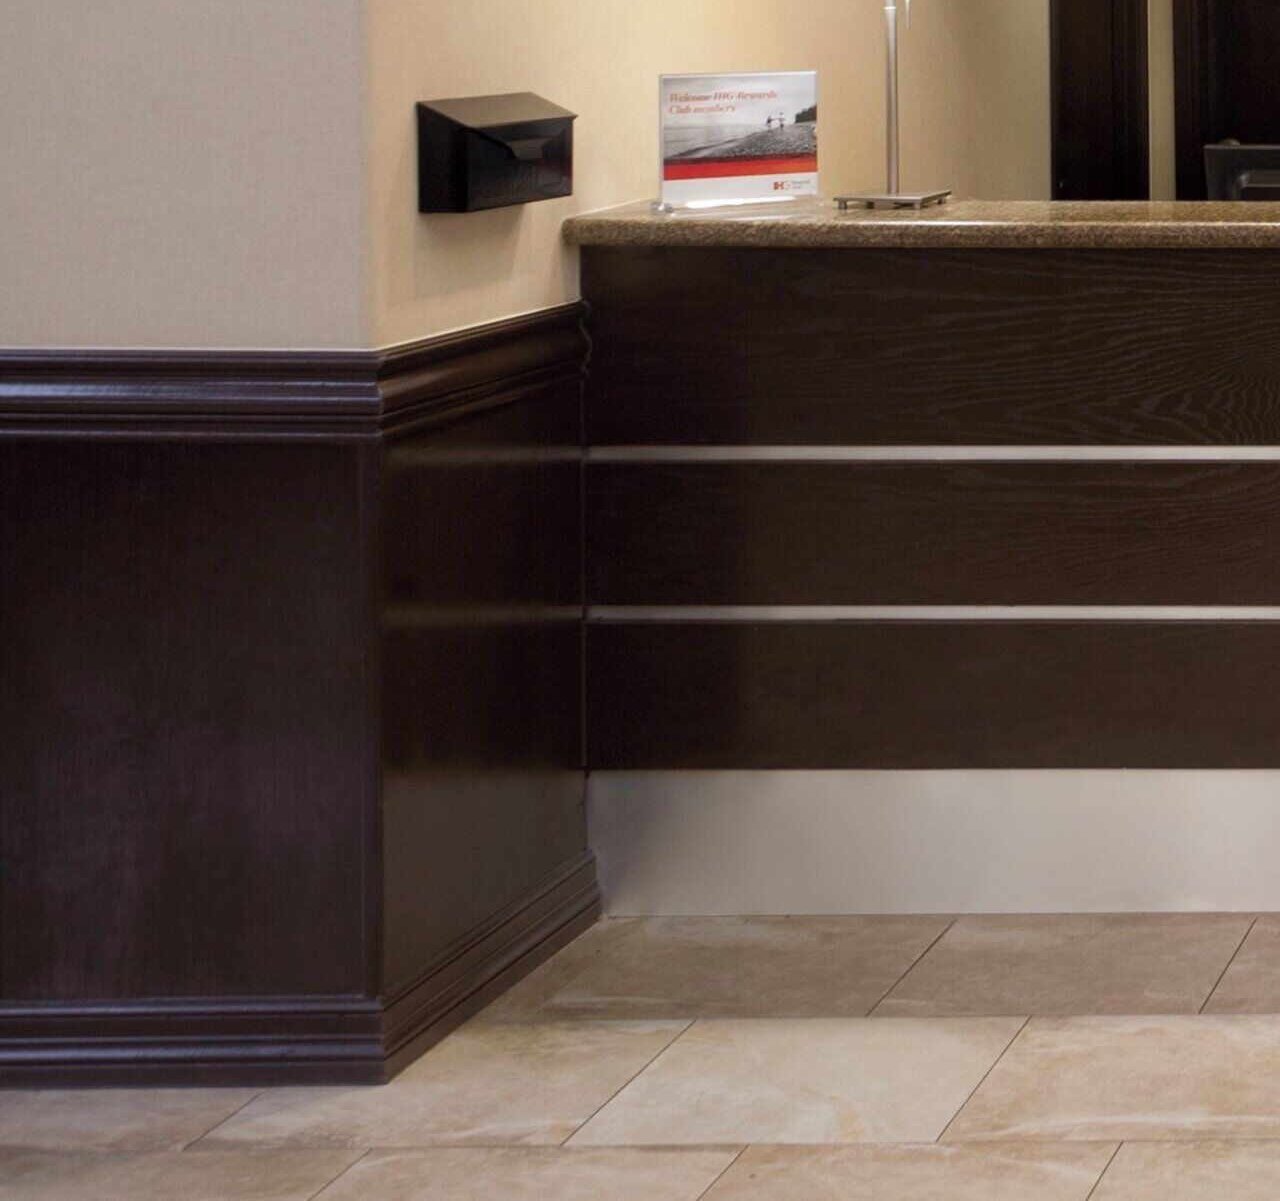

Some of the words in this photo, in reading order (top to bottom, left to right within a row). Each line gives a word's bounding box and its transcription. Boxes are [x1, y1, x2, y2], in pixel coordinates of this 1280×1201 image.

[669, 92, 711, 102] Welcome
[713, 91, 734, 101] IHG
[737, 90, 778, 100] Rewards
[669, 103, 691, 114] Club
[693, 103, 736, 113] members
